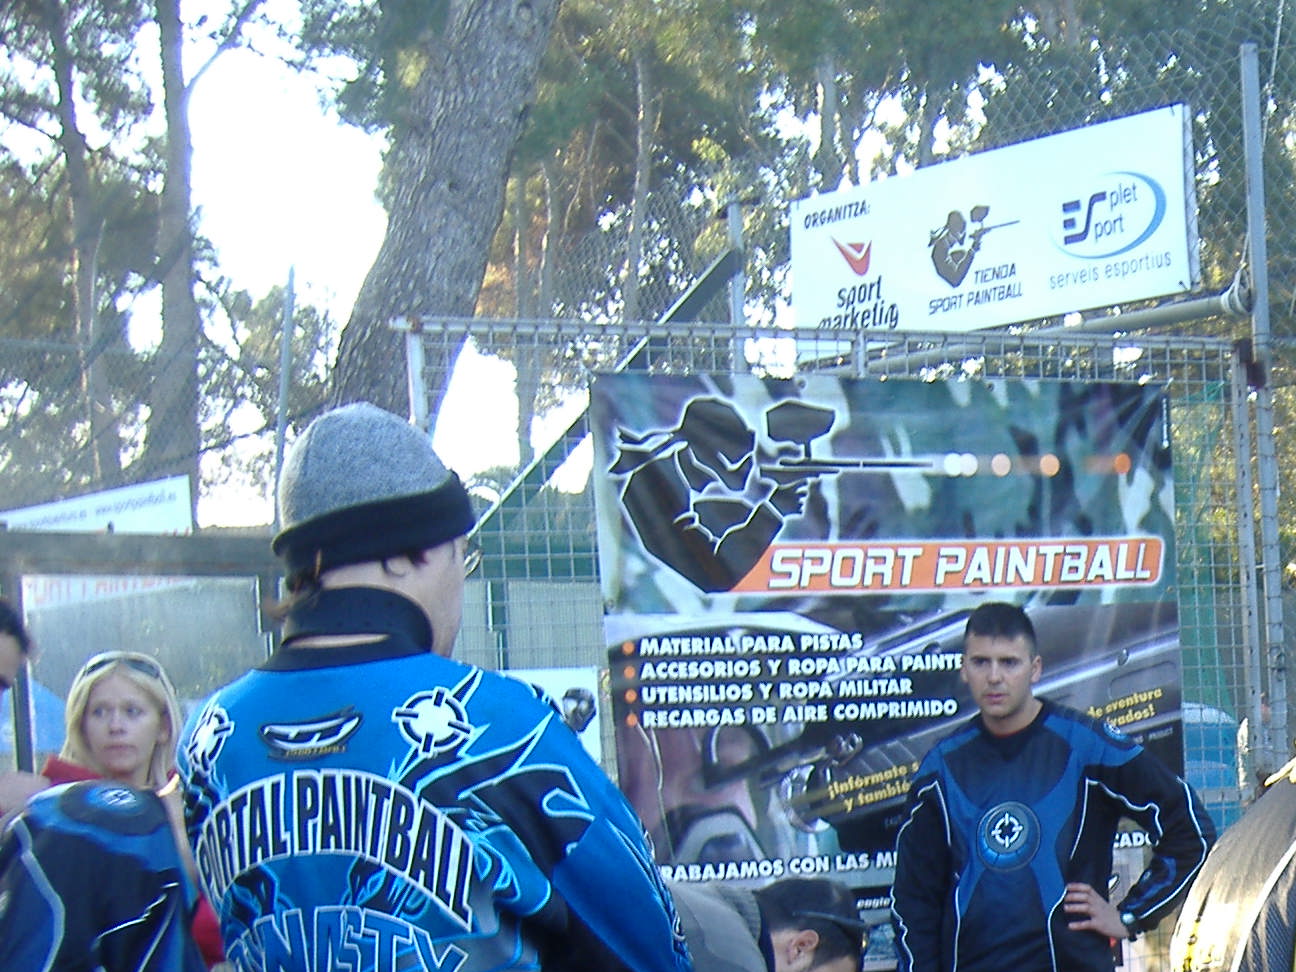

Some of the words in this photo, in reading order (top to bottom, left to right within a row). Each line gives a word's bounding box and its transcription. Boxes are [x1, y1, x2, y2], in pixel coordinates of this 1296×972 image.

[974, 263, 1016, 285] TIENDA
[1050, 266, 1099, 290] serveis
[1104, 251, 1172, 279] esportius
[837, 275, 882, 310] sport
[929, 291, 963, 315] SPORT
[967, 282, 1022, 307] PAINTBALL
[767, 545, 928, 589] SPORT
[934, 541, 1153, 587] PAINTBALL
[640, 637, 736, 656] MATERIAL
[741, 635, 795, 653] PARA
[801, 633, 863, 651] PISTAS
[641, 659, 761, 680] ACCESORIOS
[767, 659, 782, 676] Y
[788, 657, 840, 675] ROPA
[846, 656, 897, 674] PARA
[642, 683, 753, 704] UTENSILIOS
[759, 682, 773, 699] Y
[779, 680, 833, 699] ROPA
[839, 678, 913, 698] MILITAR
[1105, 688, 1162, 713] aventura
[643, 708, 746, 729] RECARGAS
[752, 706, 777, 725] DE
[783, 704, 829, 723] AIRE
[833, 699, 958, 721] COMPRIMIDO
[843, 797, 854, 814] y
[197, 772, 290, 903] PORTAL
[293, 768, 473, 934] PAINTBALL
[789, 856, 829, 873] CON
[836, 852, 869, 870] LAS
